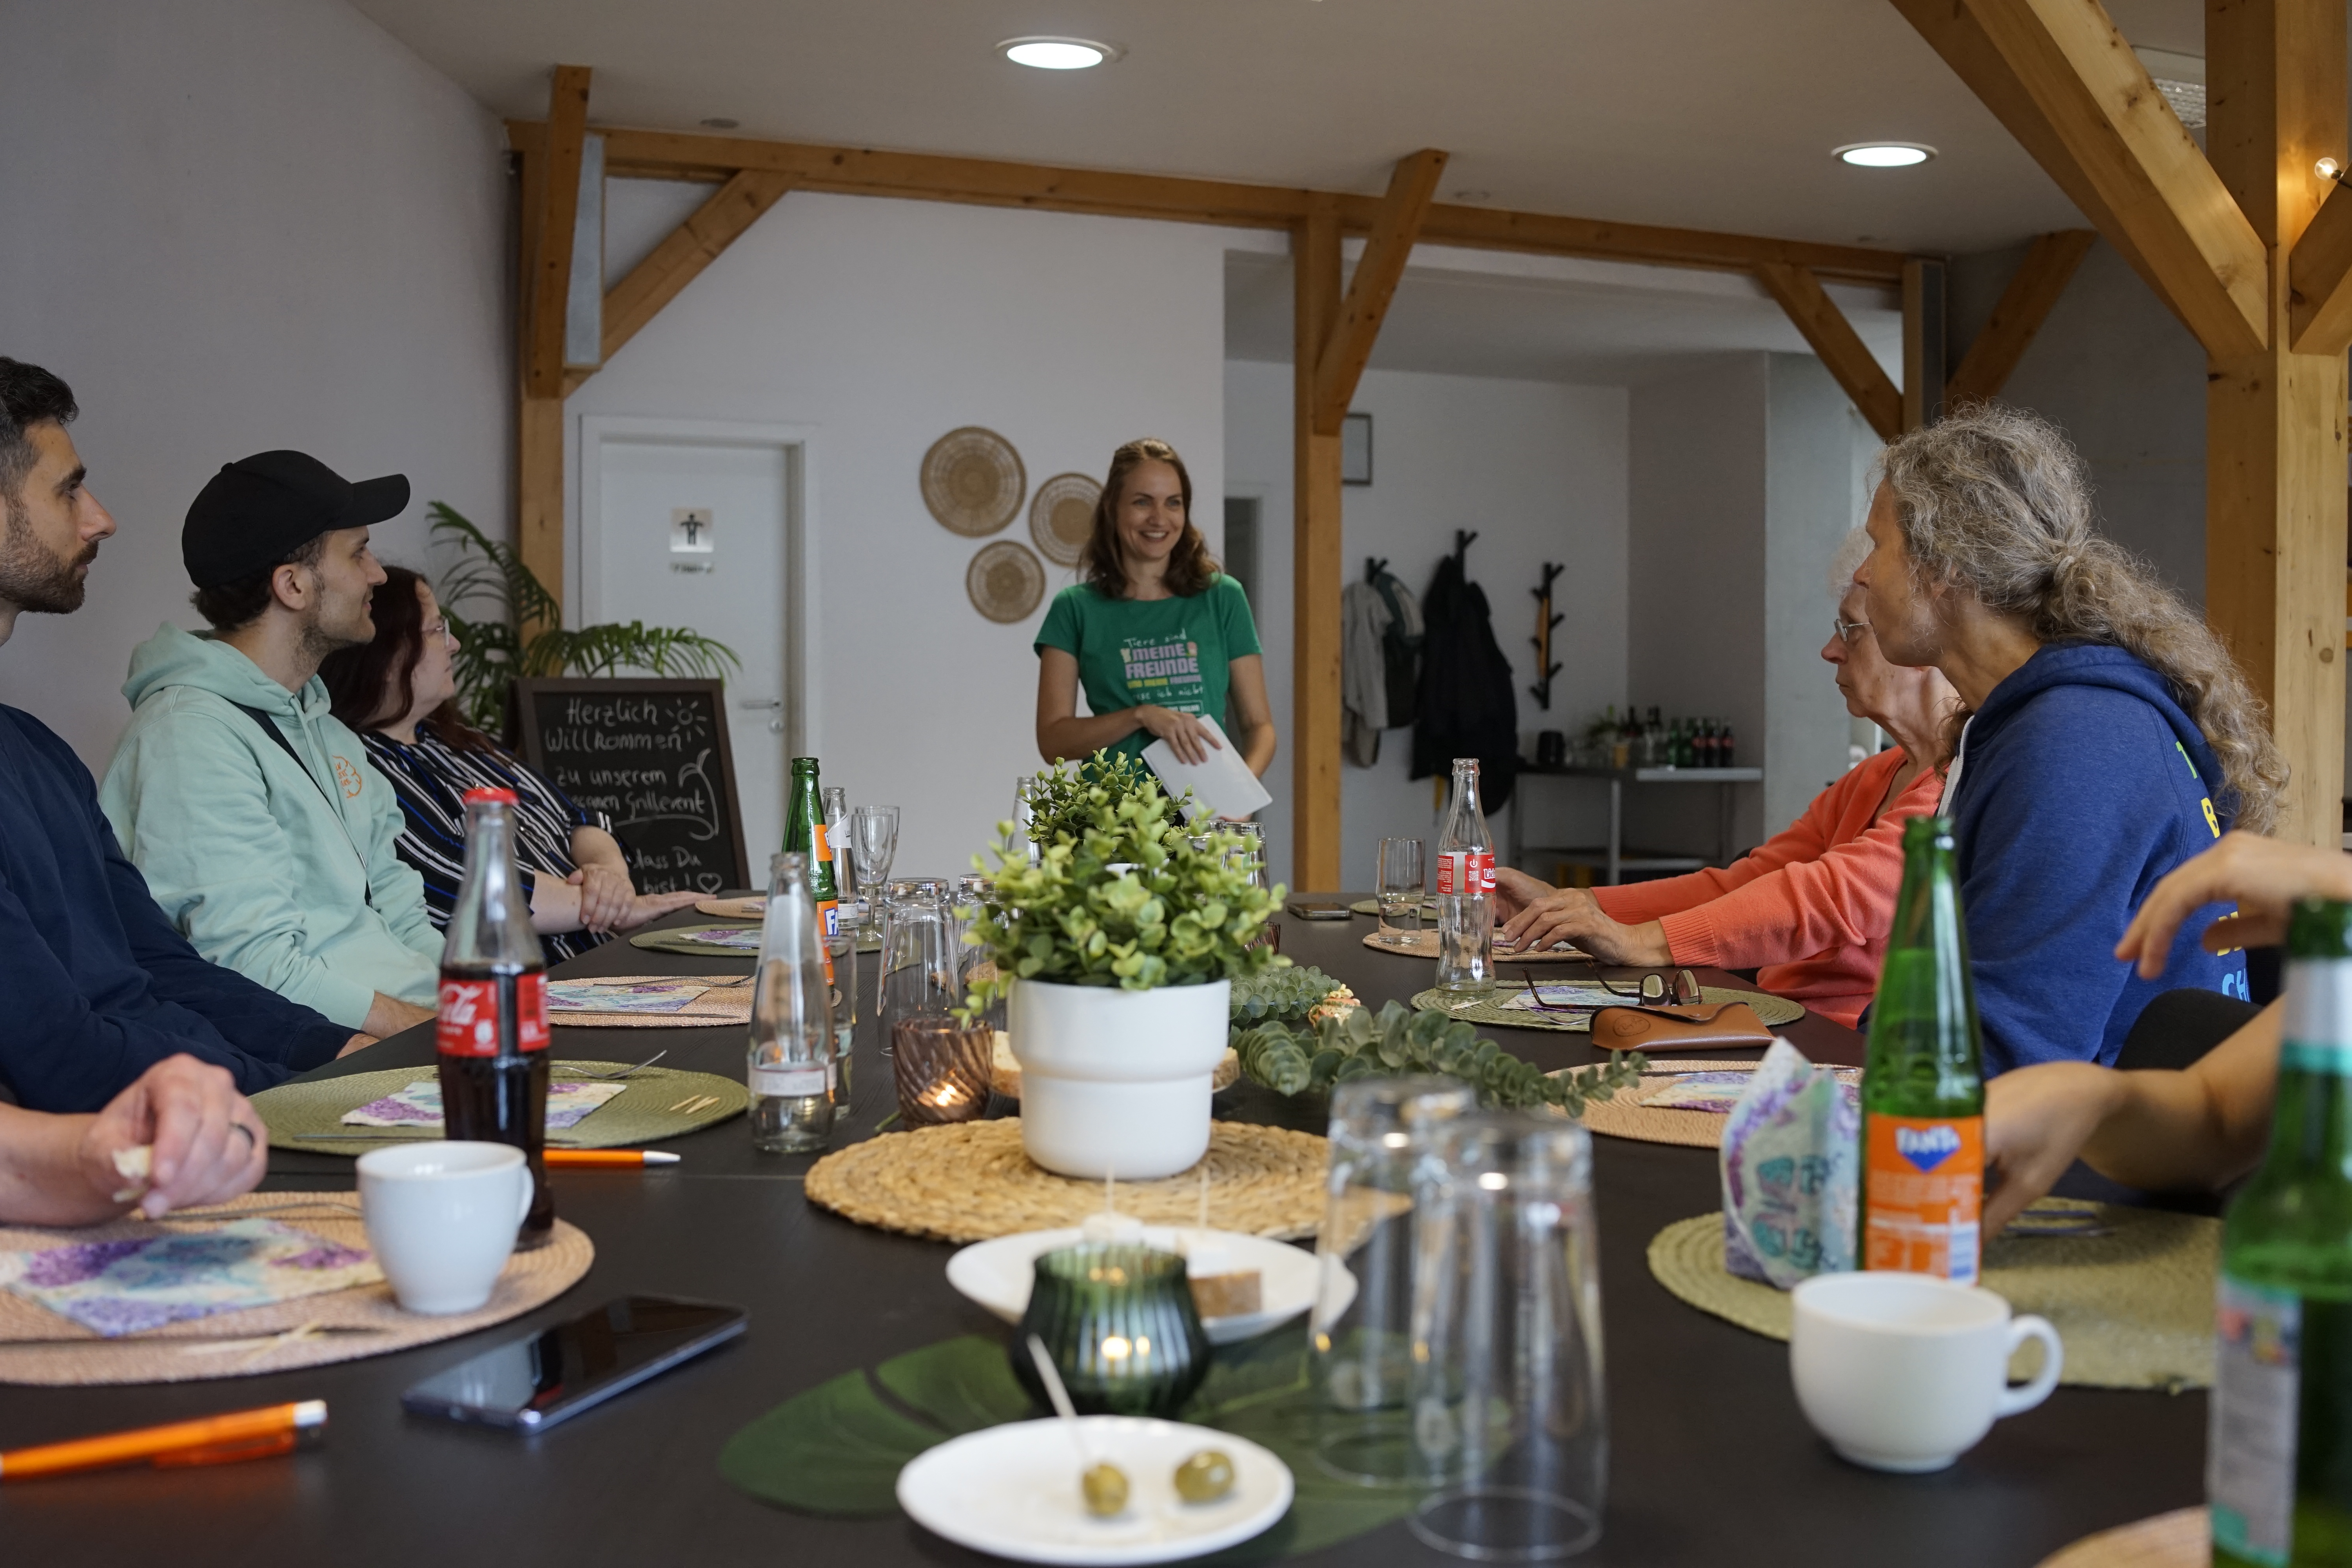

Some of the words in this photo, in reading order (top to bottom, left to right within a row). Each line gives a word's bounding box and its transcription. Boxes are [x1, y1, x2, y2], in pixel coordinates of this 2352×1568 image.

[1132, 643, 1186, 662] MEINE
[1125, 657, 1199, 679] FREUNDE
[566, 697, 659, 727] Herzlich
[545, 728, 682, 752] Willkommen
[590, 769, 668, 788] unserem
[625, 788, 705, 820] Grillevent
[671, 846, 703, 868] Du
[2222, 968, 2251, 1003] CH
